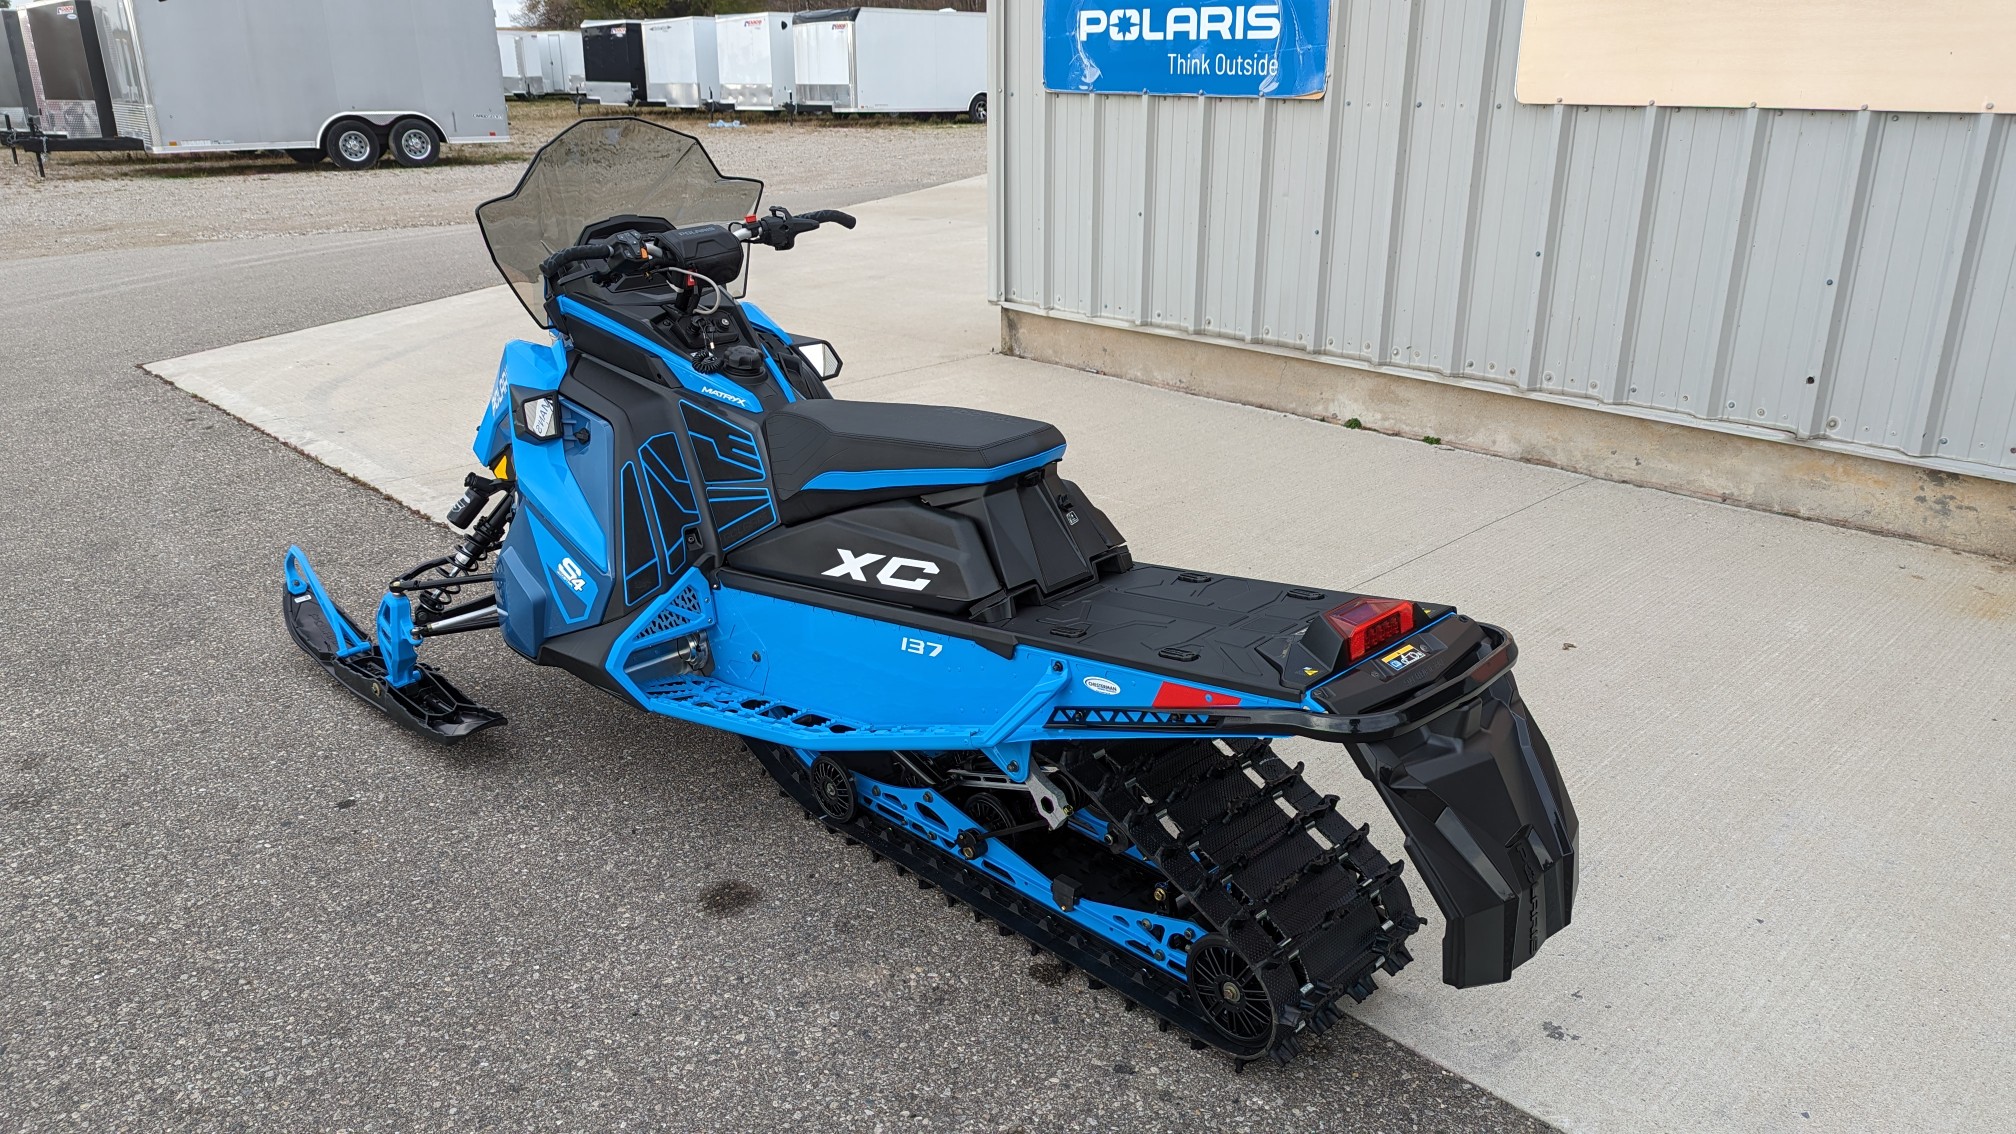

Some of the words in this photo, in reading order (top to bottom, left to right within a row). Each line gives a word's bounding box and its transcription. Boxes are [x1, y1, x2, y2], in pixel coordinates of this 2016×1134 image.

[1079, 5, 1281, 42] POLARIS
[1168, 53, 1210, 75] Think
[1215, 53, 1279, 76] Outside
[701, 386, 746, 408] MATRYX
[558, 557, 586, 592] S4
[820, 548, 941, 591] XC
[901, 637, 943, 657] 137
